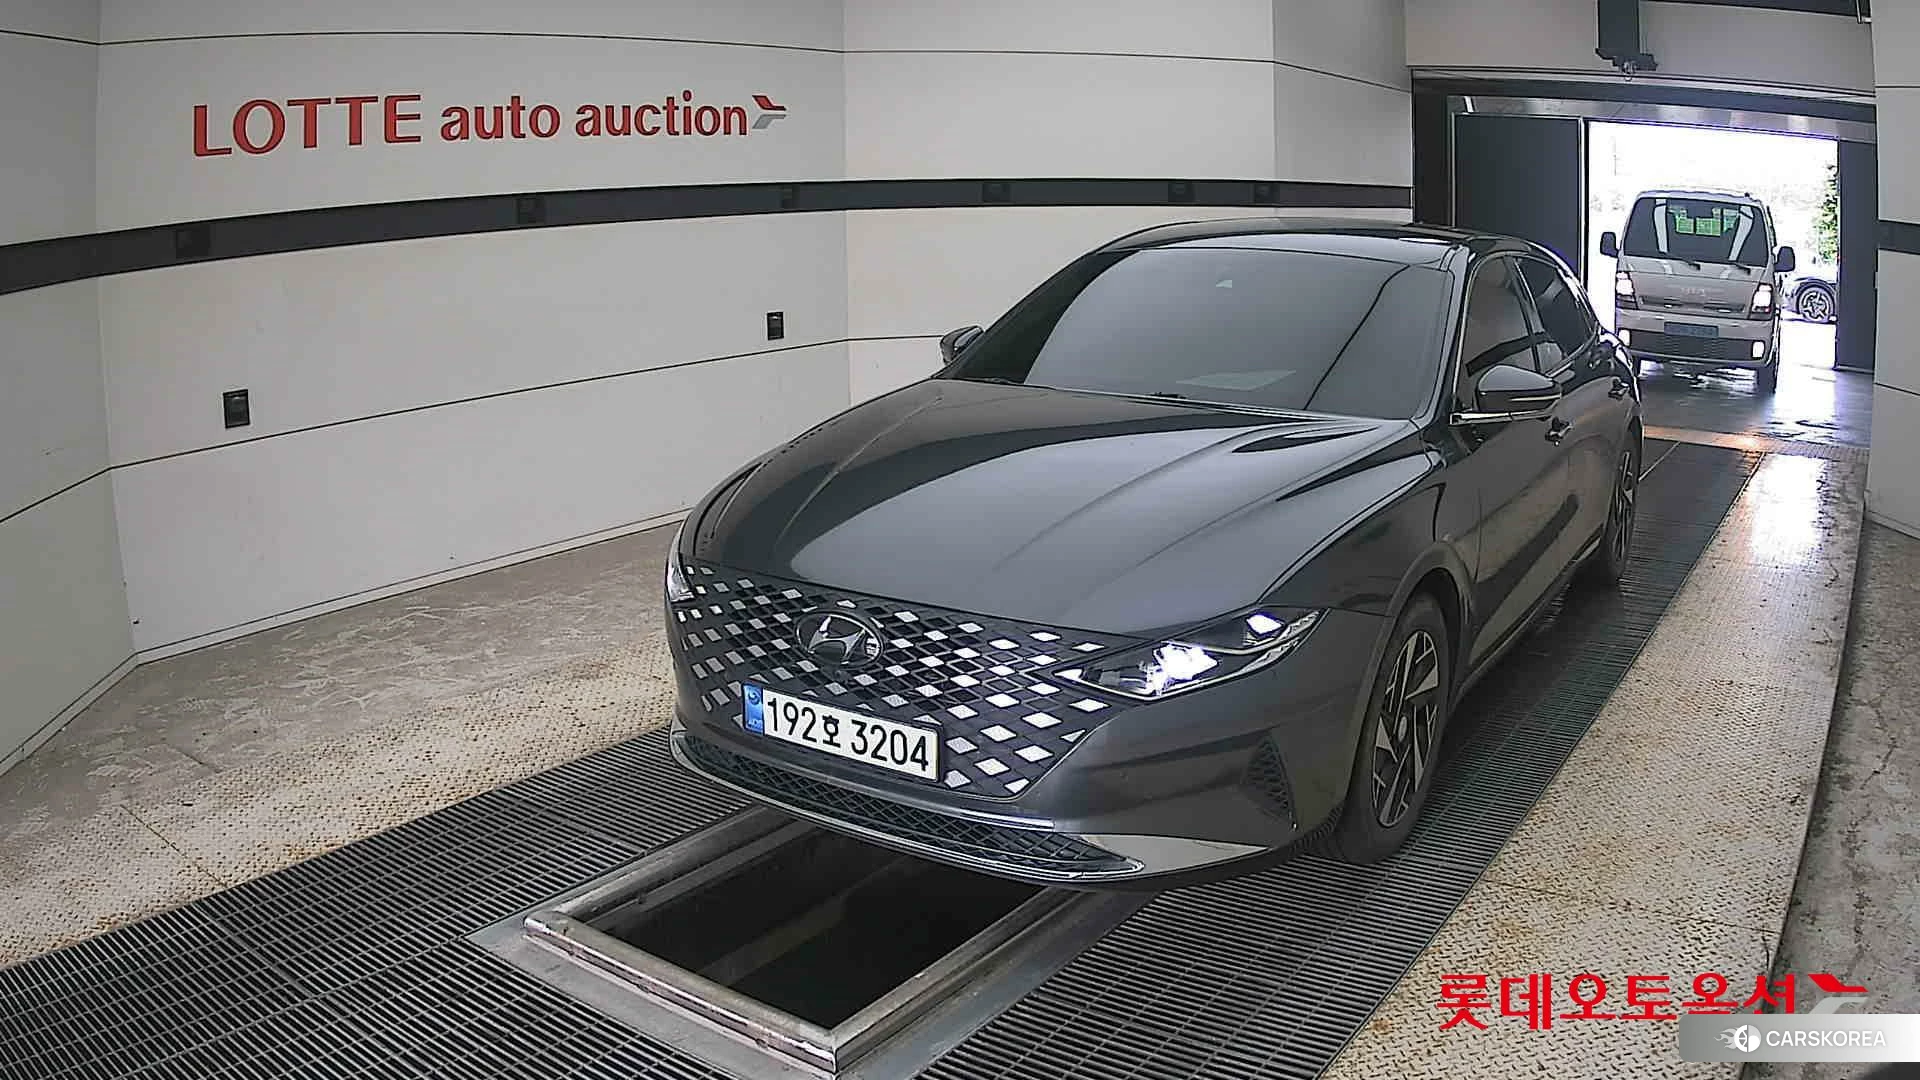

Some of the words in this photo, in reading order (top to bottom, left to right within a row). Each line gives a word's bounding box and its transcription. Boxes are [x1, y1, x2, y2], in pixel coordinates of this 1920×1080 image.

[193, 94, 421, 156] LOTTE
[440, 95, 560, 141] auto
[575, 90, 748, 137] auction
[851, 719, 929, 771] 3204
